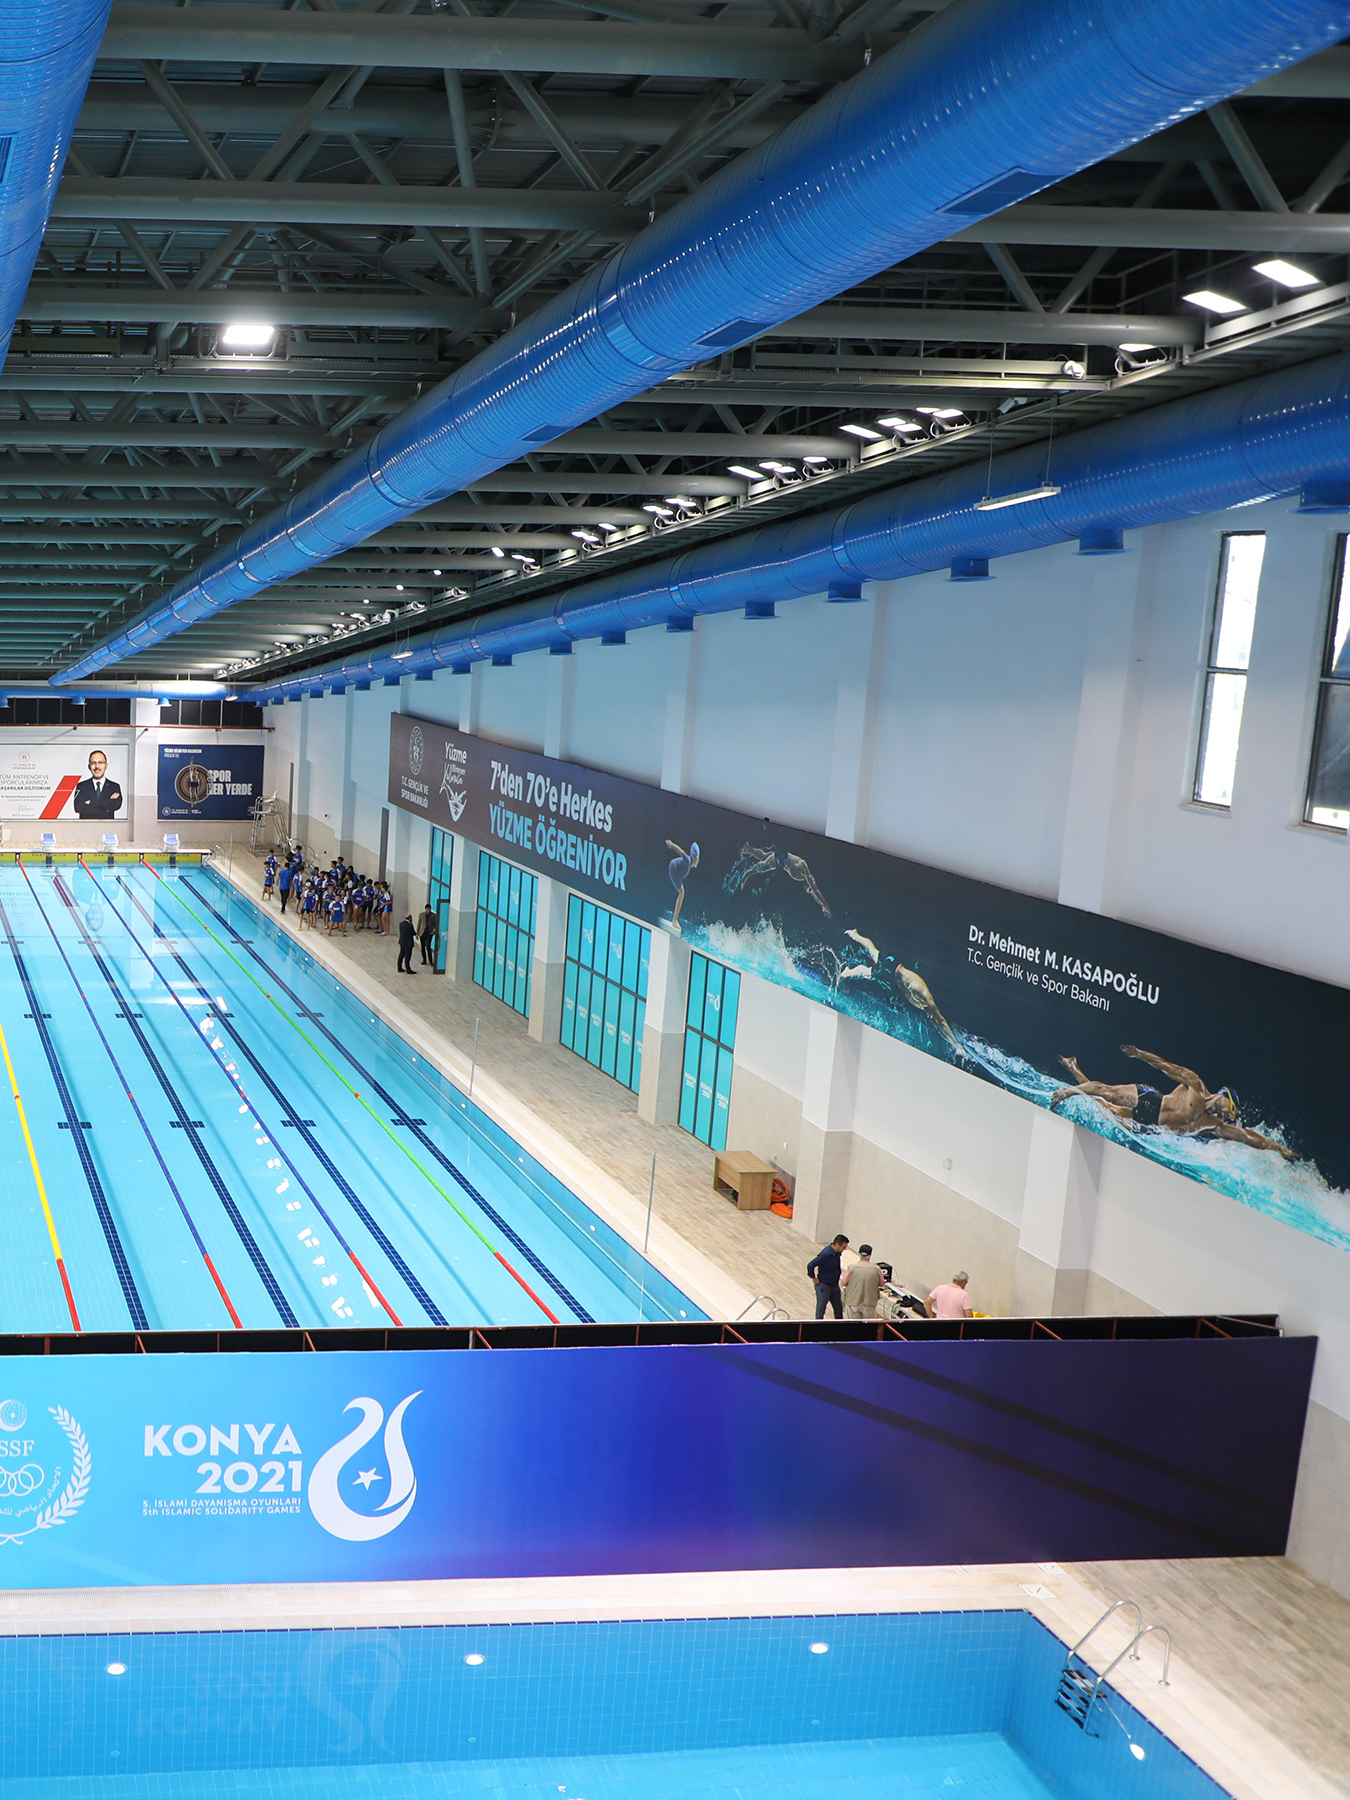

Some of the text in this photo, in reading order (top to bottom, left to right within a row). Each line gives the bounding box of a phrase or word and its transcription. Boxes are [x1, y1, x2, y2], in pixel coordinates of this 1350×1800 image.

[445, 741, 467, 764] Yüzme
[207, 770, 231, 782] SPOR
[207, 783, 252, 795] HER YERDE
[559, 781, 613, 833] Herkes
[489, 800, 627, 891] YÜZME ÖĞRENİYOR
[967, 947, 1110, 1012] T.C. Gençlik ve Spor Bakanı
[968, 924, 1160, 1005] Dr. Mehmet M. KASAPOĞLU
[144, 1423, 303, 1456] KONYA
[195, 1460, 303, 1493] 2021
[142, 1497, 301, 1510] 5. İSLAMİ DAYANIŞMA OYUNLARI
[142, 1505, 301, 1516] 5th ISLAMIC SOLIDARITY GAMES
